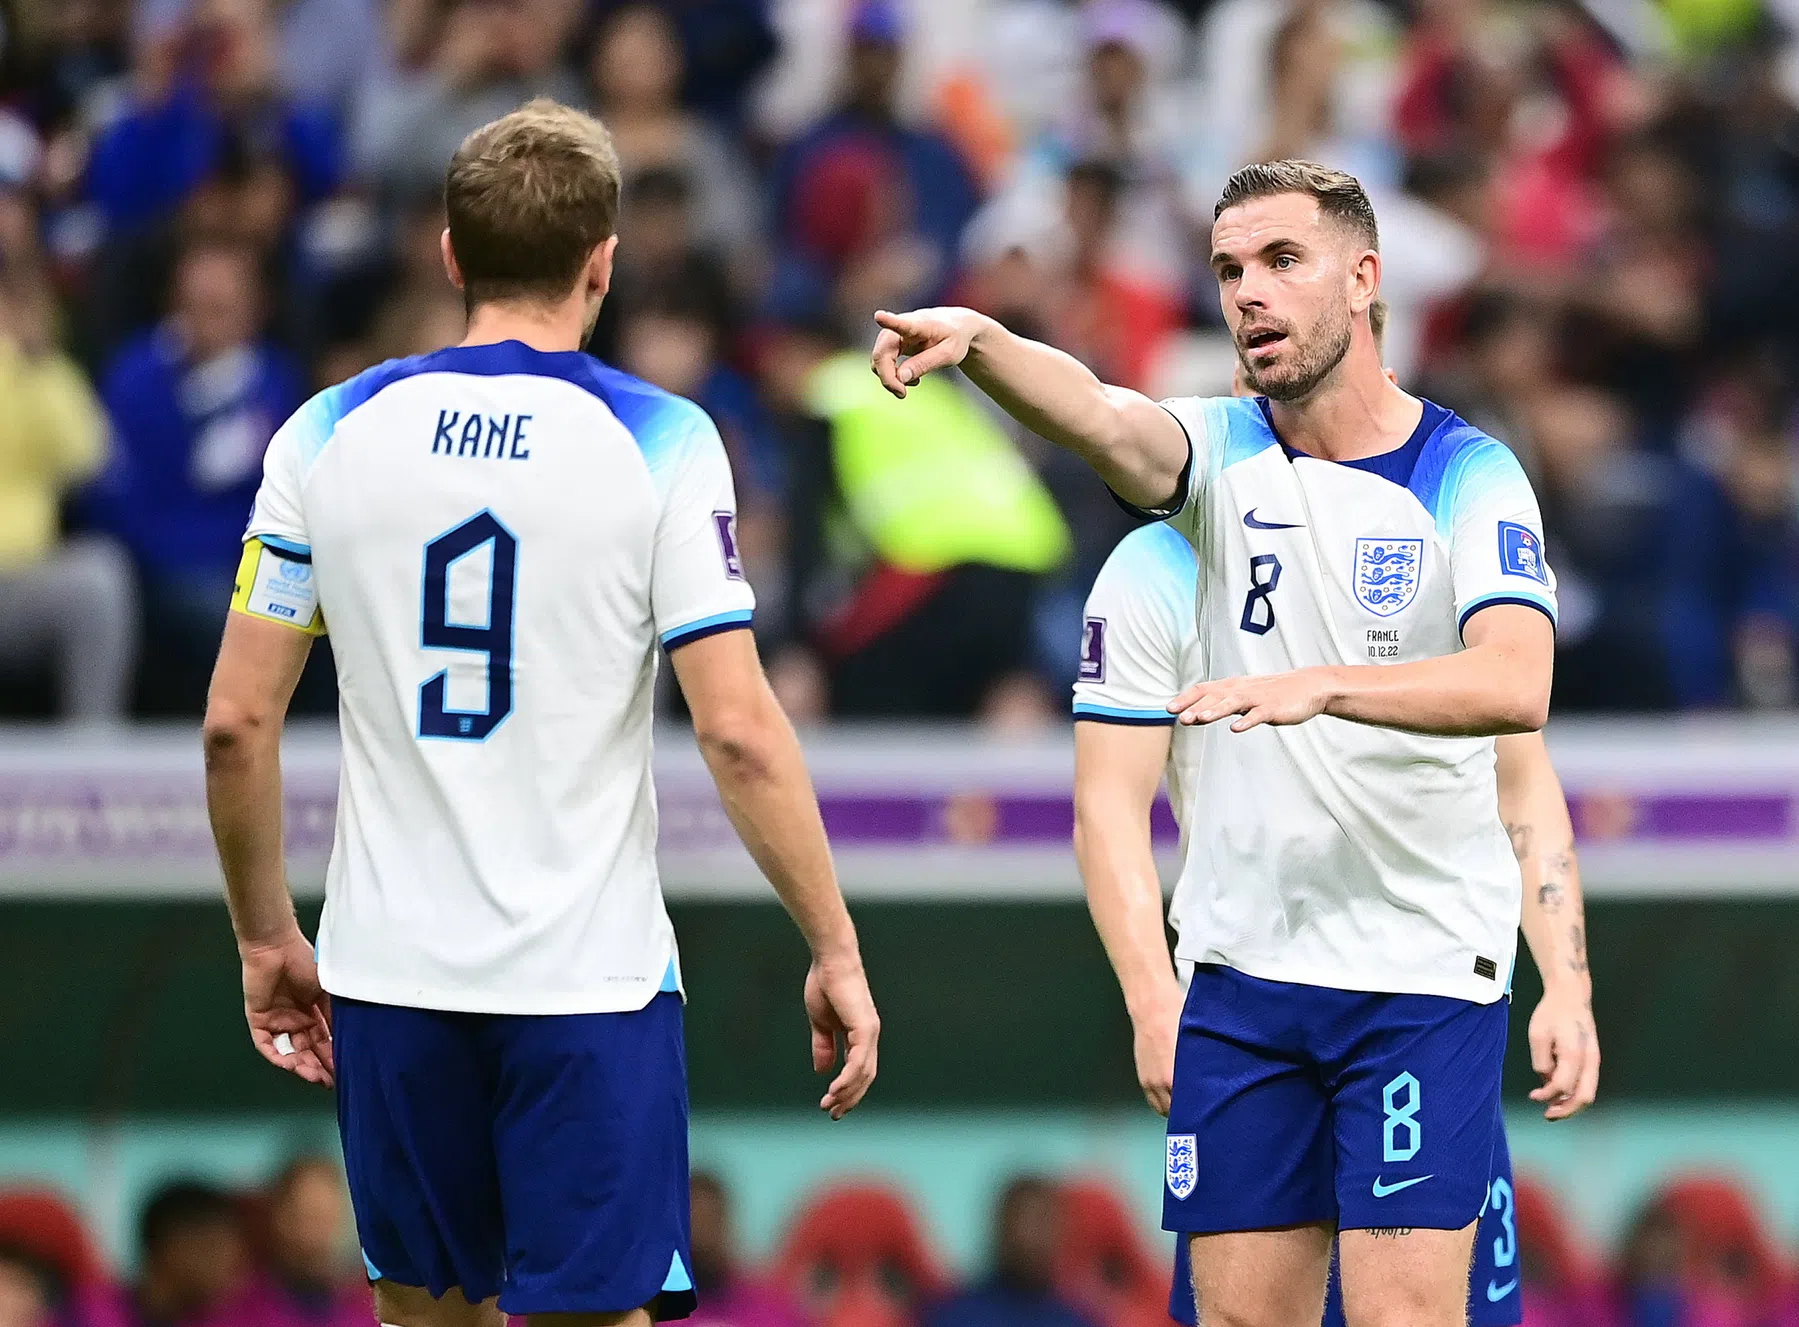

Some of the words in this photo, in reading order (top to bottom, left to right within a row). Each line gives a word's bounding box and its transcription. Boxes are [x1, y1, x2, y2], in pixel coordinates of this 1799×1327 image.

[431, 409, 533, 460] KANE
[416, 507, 520, 743] 9
[1240, 553, 1283, 635] 8
[1366, 629, 1399, 642] FRANCE
[1367, 645, 1399, 658] 10.12.22
[1382, 1071, 1421, 1162] 8
[1491, 1176, 1516, 1268] 3
